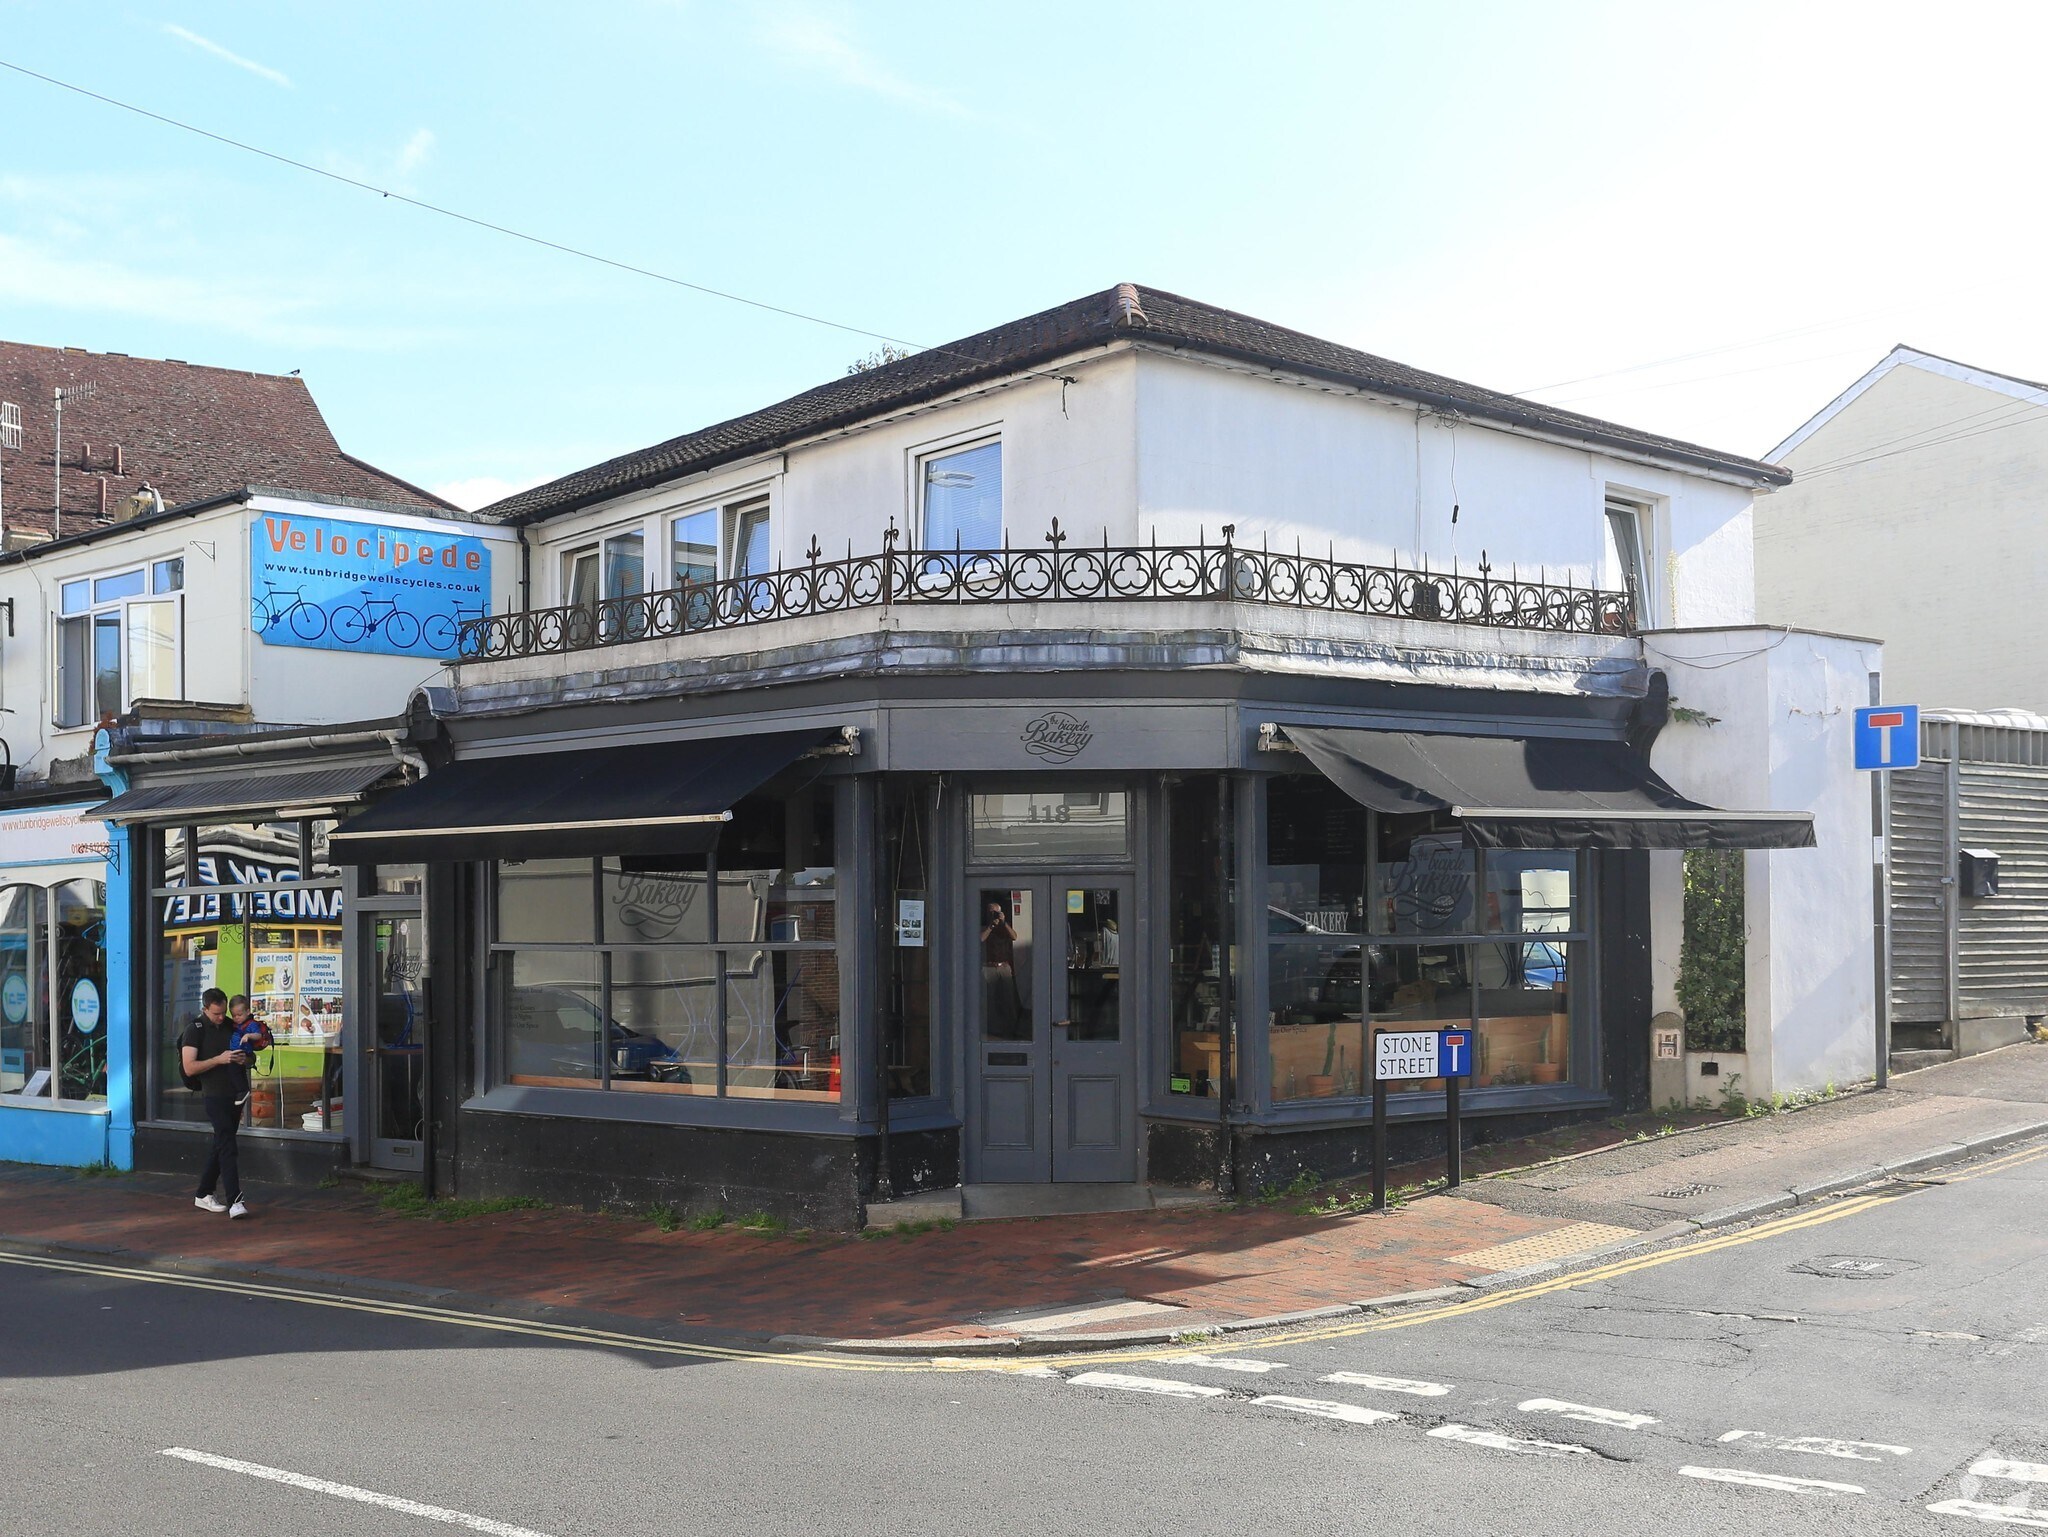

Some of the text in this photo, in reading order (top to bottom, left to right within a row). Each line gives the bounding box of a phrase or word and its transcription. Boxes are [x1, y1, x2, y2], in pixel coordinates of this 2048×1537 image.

[264, 517, 481, 571] Velocipede
[265, 563, 481, 593] www.tunbridgewellscycles.co.uk
[1020, 719, 1094, 750] Bakery
[1058, 719, 1090, 733] bicycle
[1, 813, 103, 831] www.tunbridgewellscycl
[1028, 805, 1070, 823] 118
[612, 874, 699, 912] Bakery
[1383, 1036, 1432, 1054] STONE
[1380, 1057, 1434, 1075] STREET
